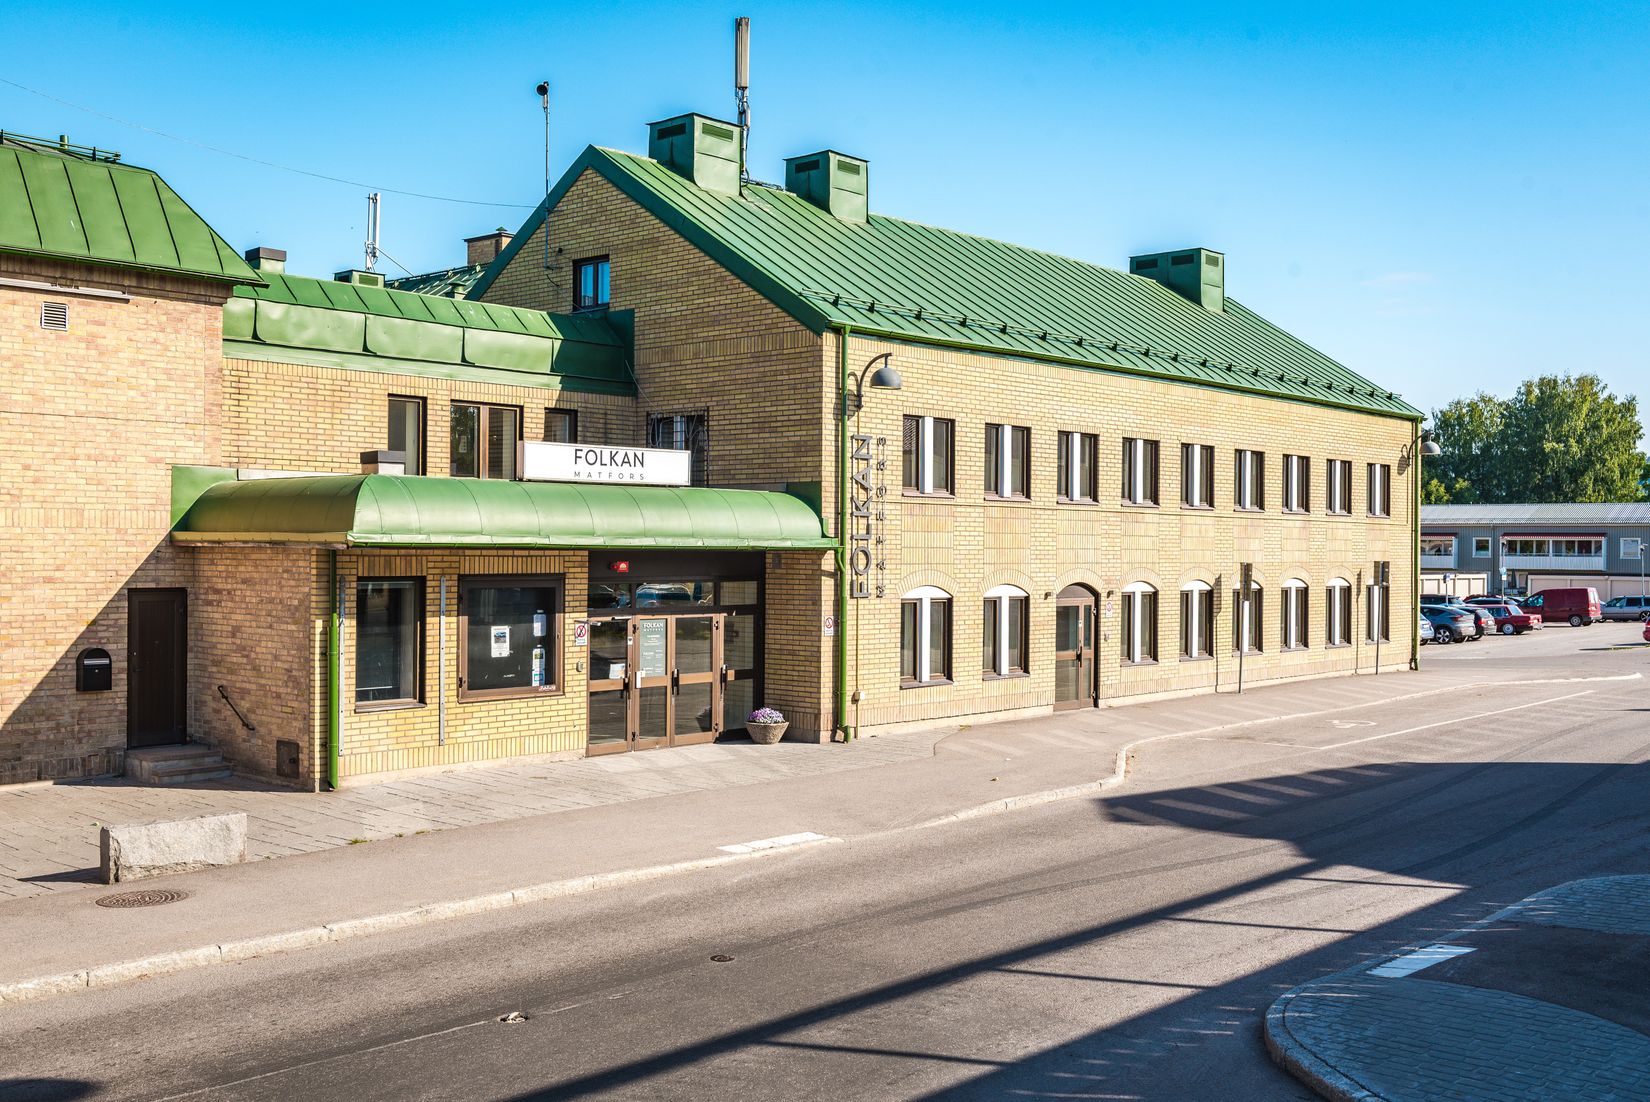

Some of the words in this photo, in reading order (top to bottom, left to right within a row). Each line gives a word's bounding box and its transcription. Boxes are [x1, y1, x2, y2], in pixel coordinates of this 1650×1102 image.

[574, 448, 645, 468] FOLKAN
[574, 471, 645, 481] MATFORS
[851, 434, 873, 599] FOLKAN
[876, 436, 887, 599] MATFORS
